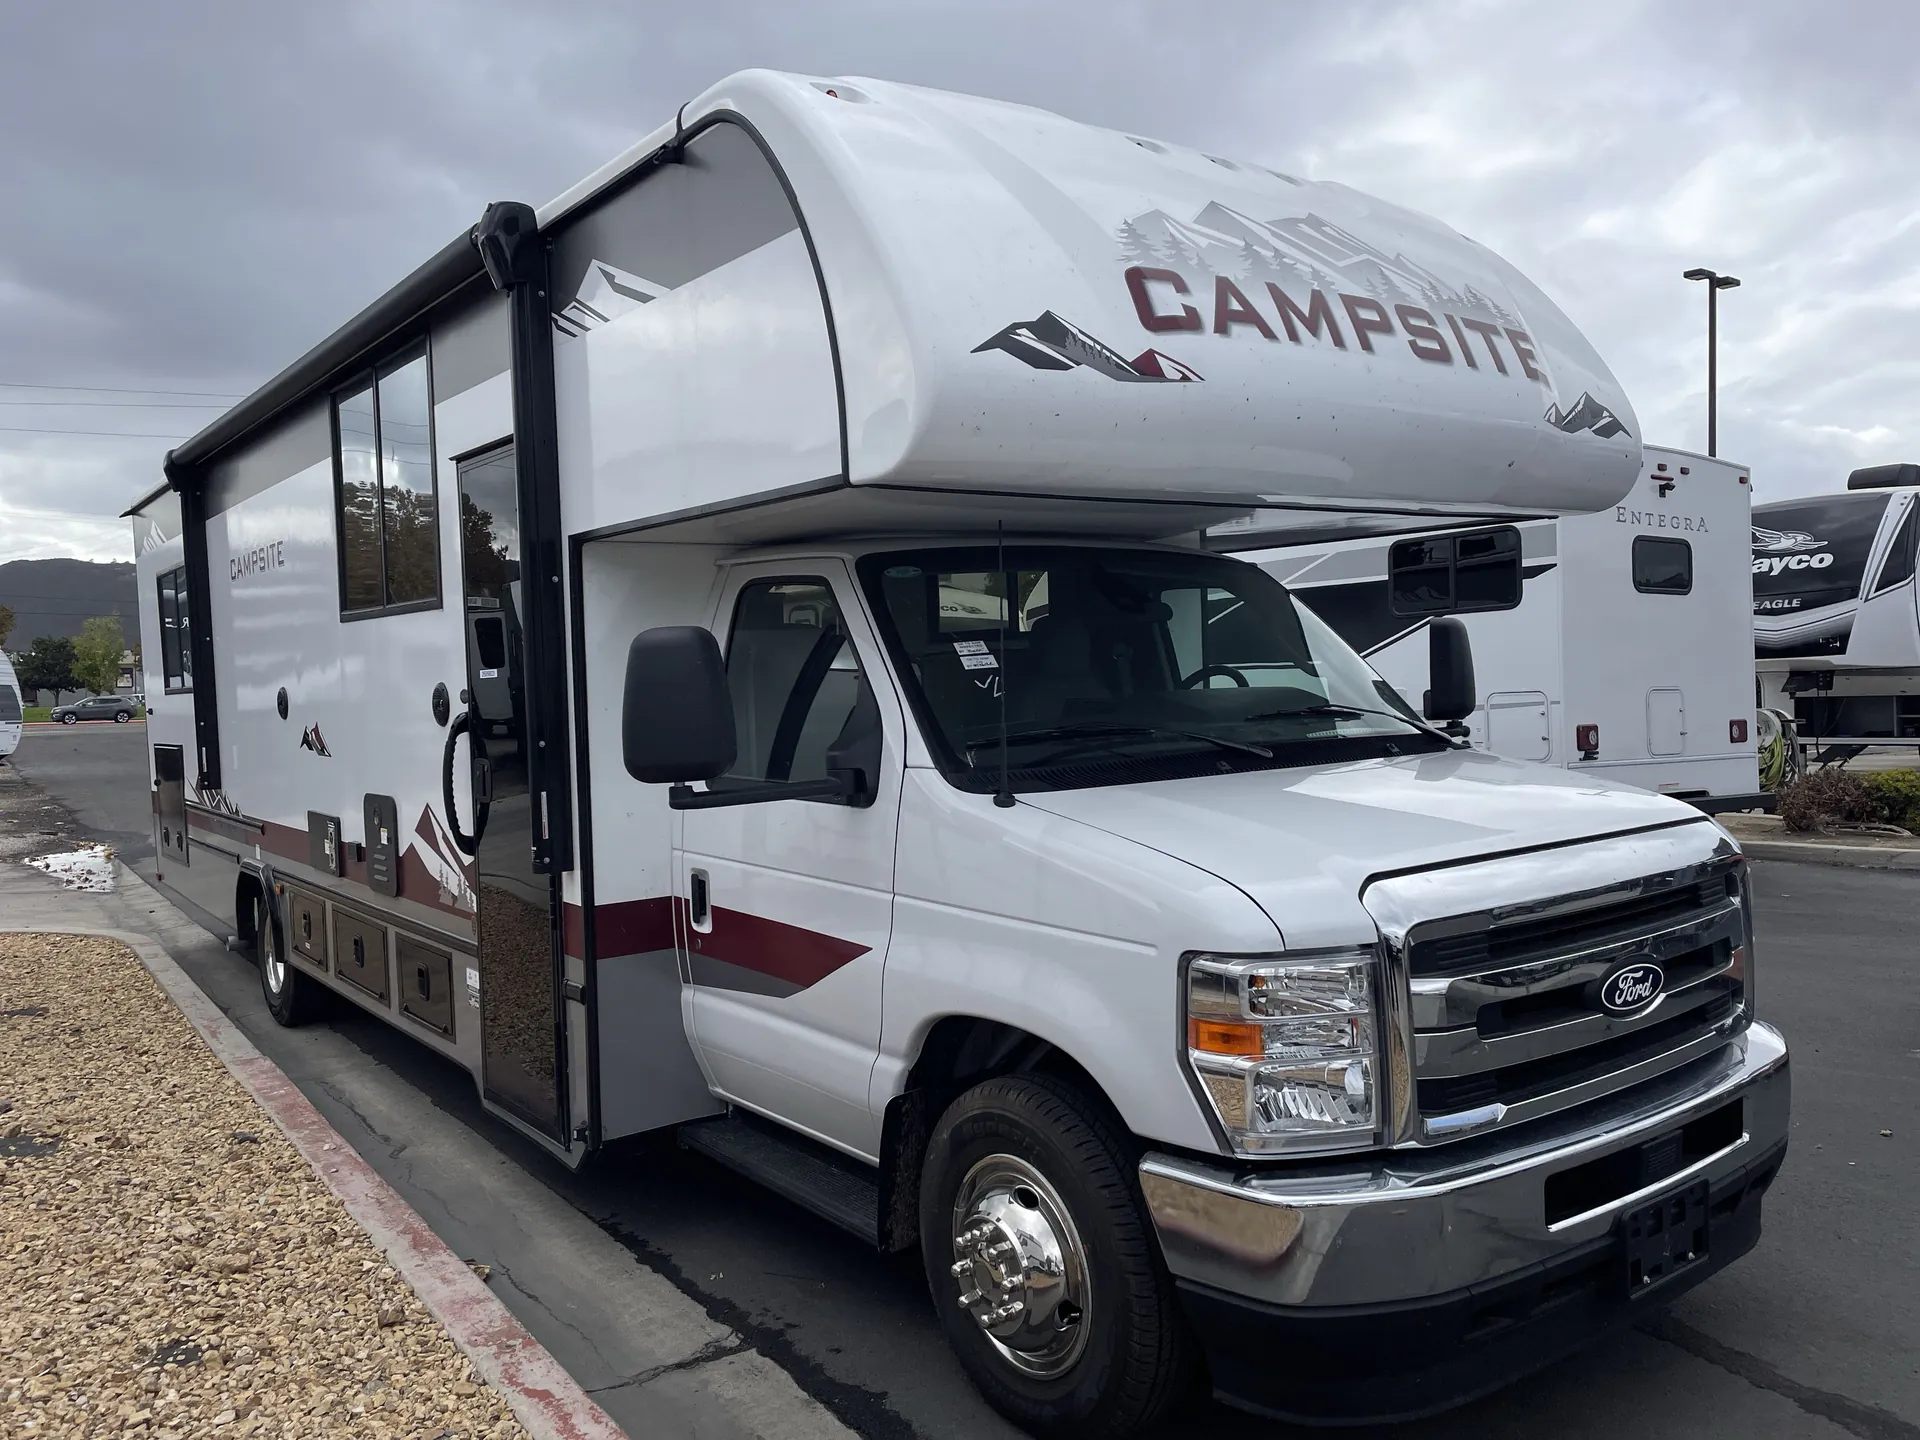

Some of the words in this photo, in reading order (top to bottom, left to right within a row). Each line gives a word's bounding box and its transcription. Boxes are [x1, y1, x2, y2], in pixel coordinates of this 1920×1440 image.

[1124, 266, 1549, 389] CAMPSITE
[1615, 505, 1709, 533] ENTEGRA
[230, 540, 285, 582] CAMPSITE
[1615, 970, 1653, 1004] Ford
